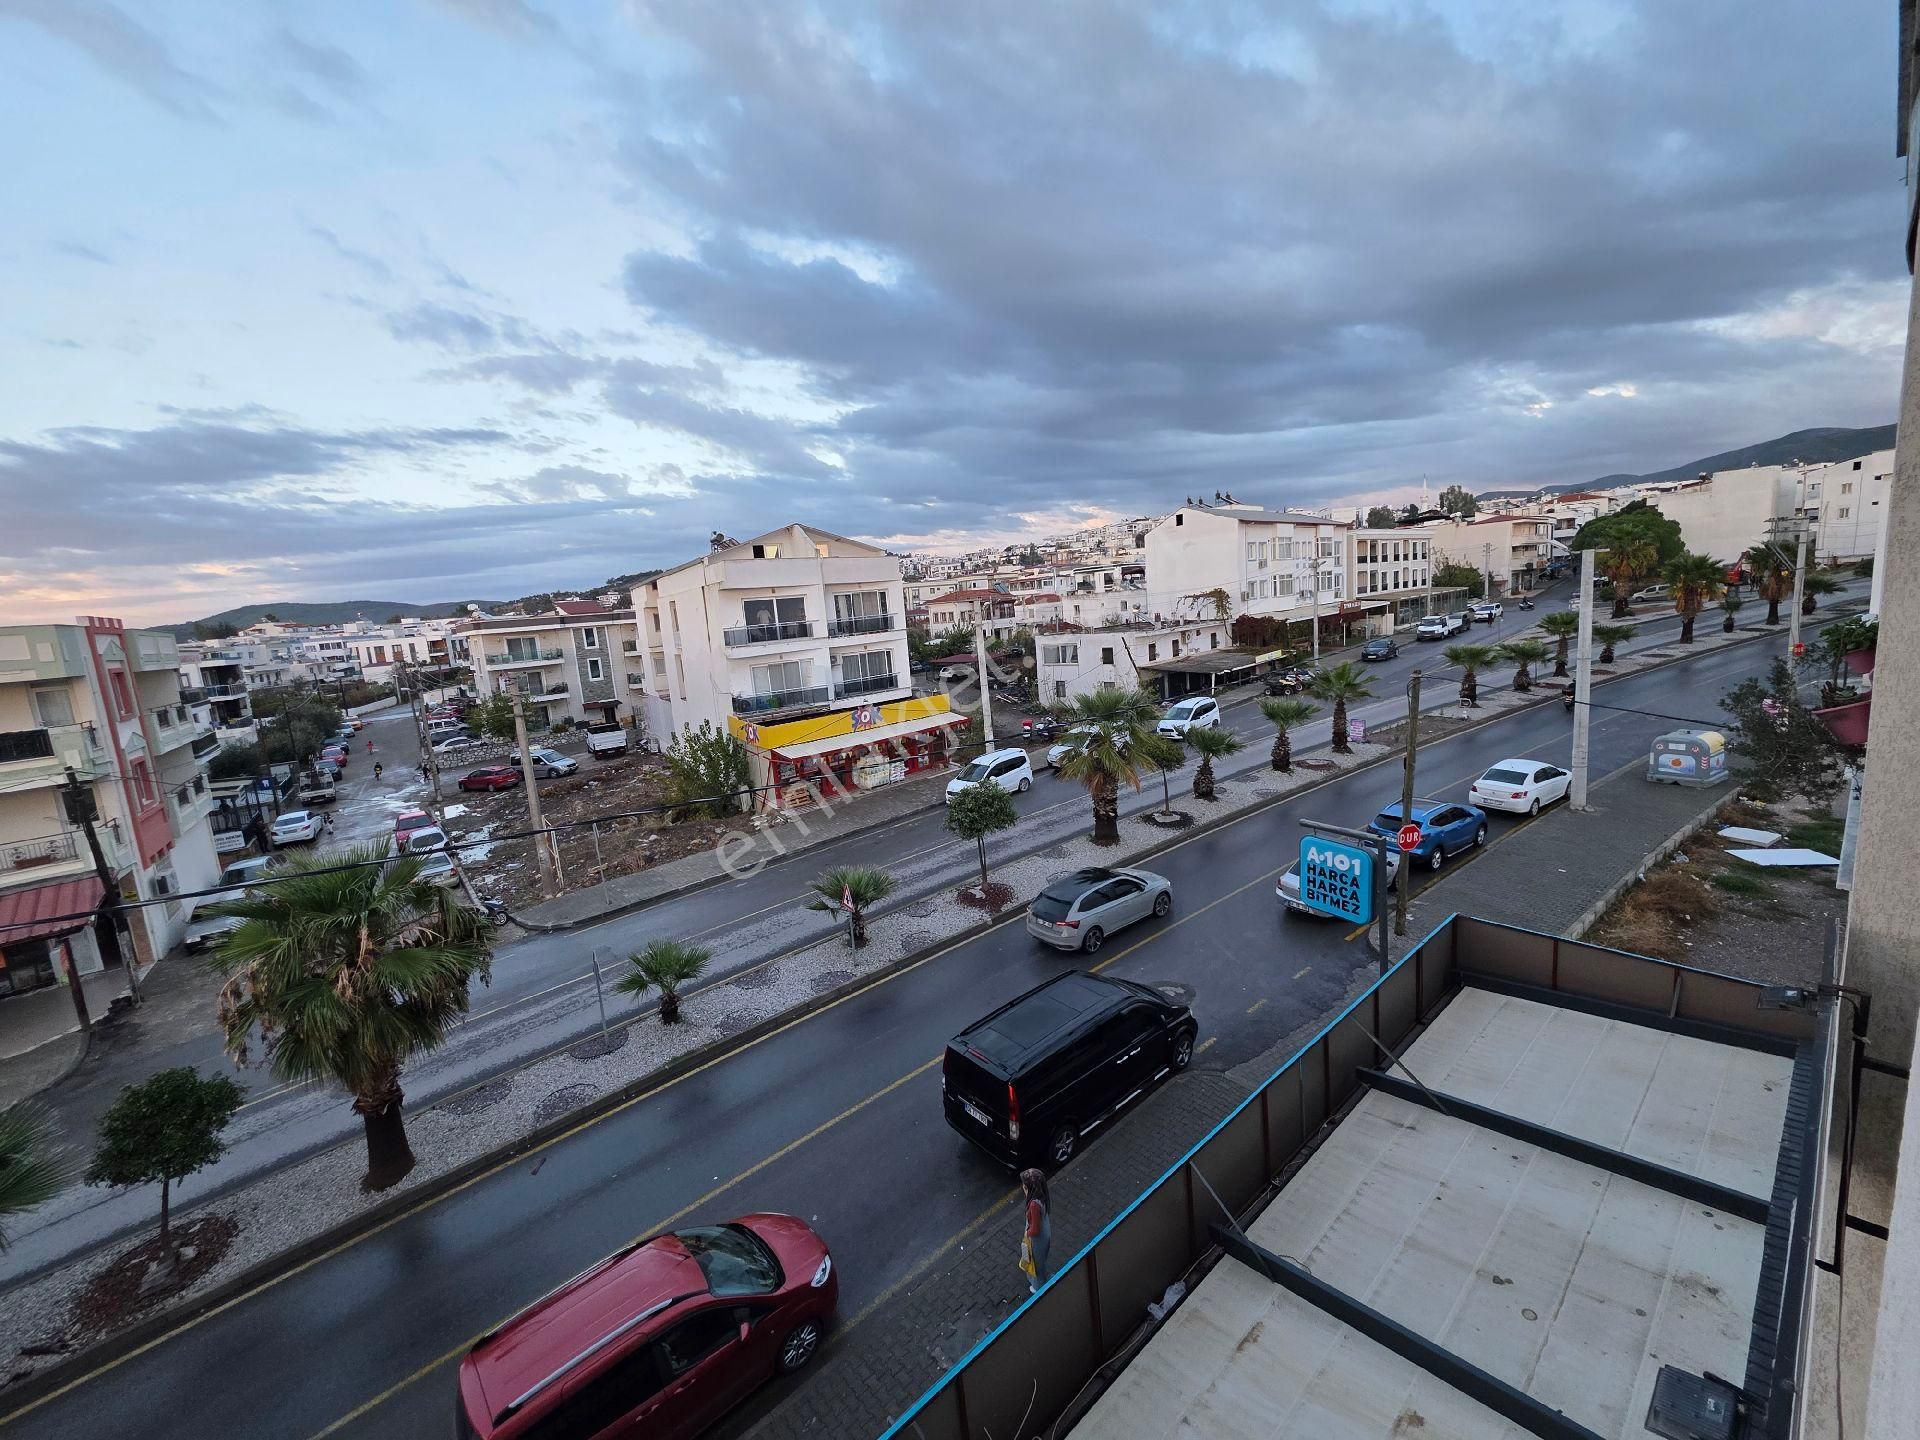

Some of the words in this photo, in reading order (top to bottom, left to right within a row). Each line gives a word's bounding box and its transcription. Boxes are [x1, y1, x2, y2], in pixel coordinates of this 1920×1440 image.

[1400, 831, 1419, 844] DUR
[1307, 863, 1360, 889] HARCA
[1307, 875, 1360, 903] HARCA
